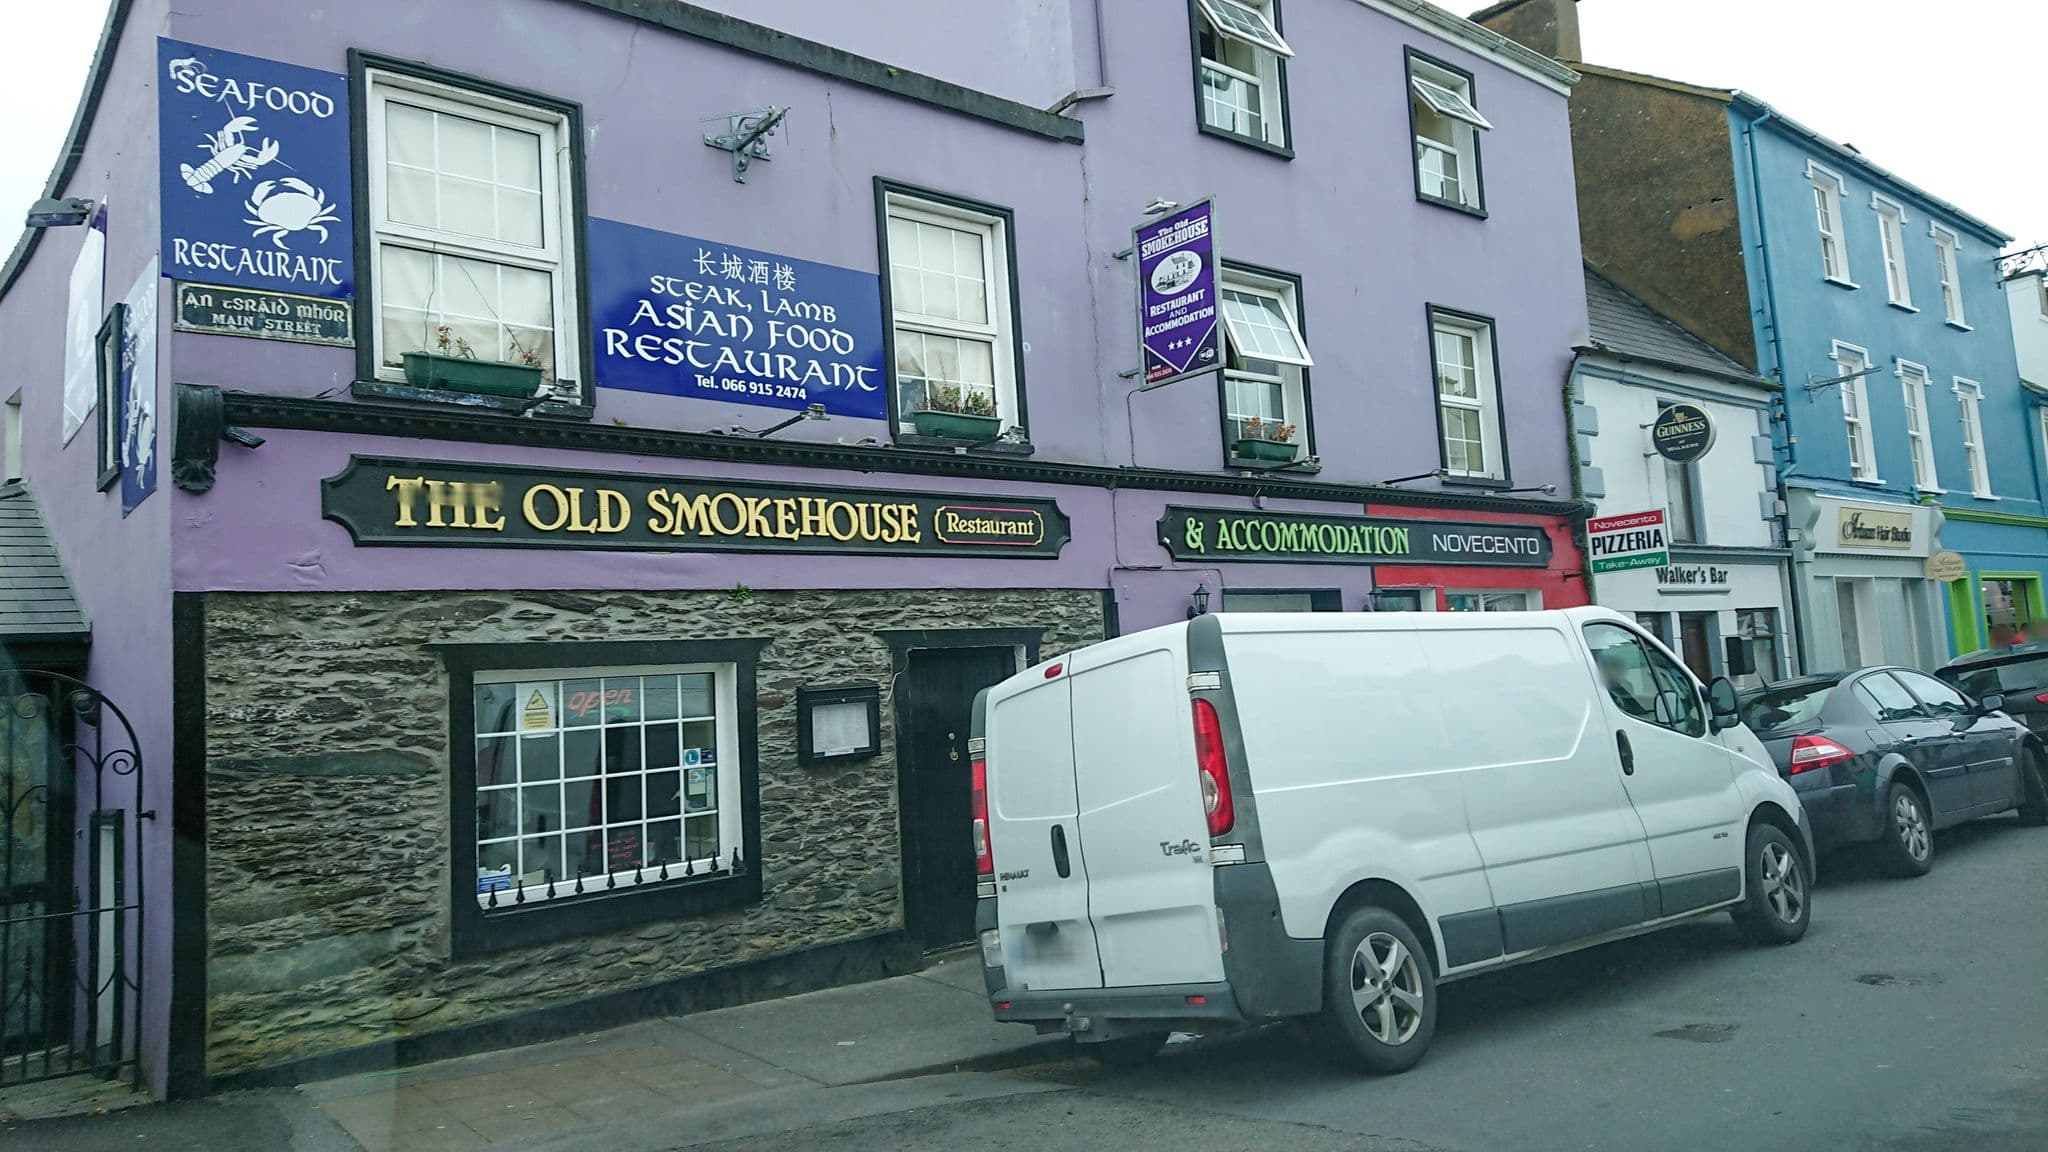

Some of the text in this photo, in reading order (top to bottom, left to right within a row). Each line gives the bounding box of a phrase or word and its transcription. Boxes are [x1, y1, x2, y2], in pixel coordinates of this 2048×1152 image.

[176, 67, 334, 118] SEAFOOD
[1141, 219, 1209, 258] SMOKEHOUSE
[1157, 218, 1189, 237] The Old
[173, 238, 343, 285] RESTAURANT
[693, 247, 796, 292] 长城酒楼
[650, 275, 837, 323] STEAK, LAMB
[1150, 288, 1205, 317] RESTAURANT
[1169, 306, 1188, 319] AND
[212, 313, 322, 334] MAIN STREET
[629, 300, 854, 355] ASIAN FOOD
[1145, 305, 1214, 338] ACCOMMODATION
[602, 328, 879, 392] RESTAURANT
[694, 374, 807, 400] Tel. 066 915 2474
[1657, 420, 1706, 438] GUINNESS
[386, 475, 921, 545] THE OLD SMOKEHOUSE
[1594, 515, 1657, 530] Novecento
[946, 512, 1035, 536] Restaurant
[1185, 517, 1410, 555] & ACCOMMODATION
[1433, 533, 1540, 556] NOVECENTO
[1592, 529, 1664, 556] PIZZERIA
[1598, 555, 1662, 571] Take-Away
[1656, 566, 1728, 585] Walker's Bar
[567, 688, 633, 716] open
[1160, 838, 1201, 856] Trafic
